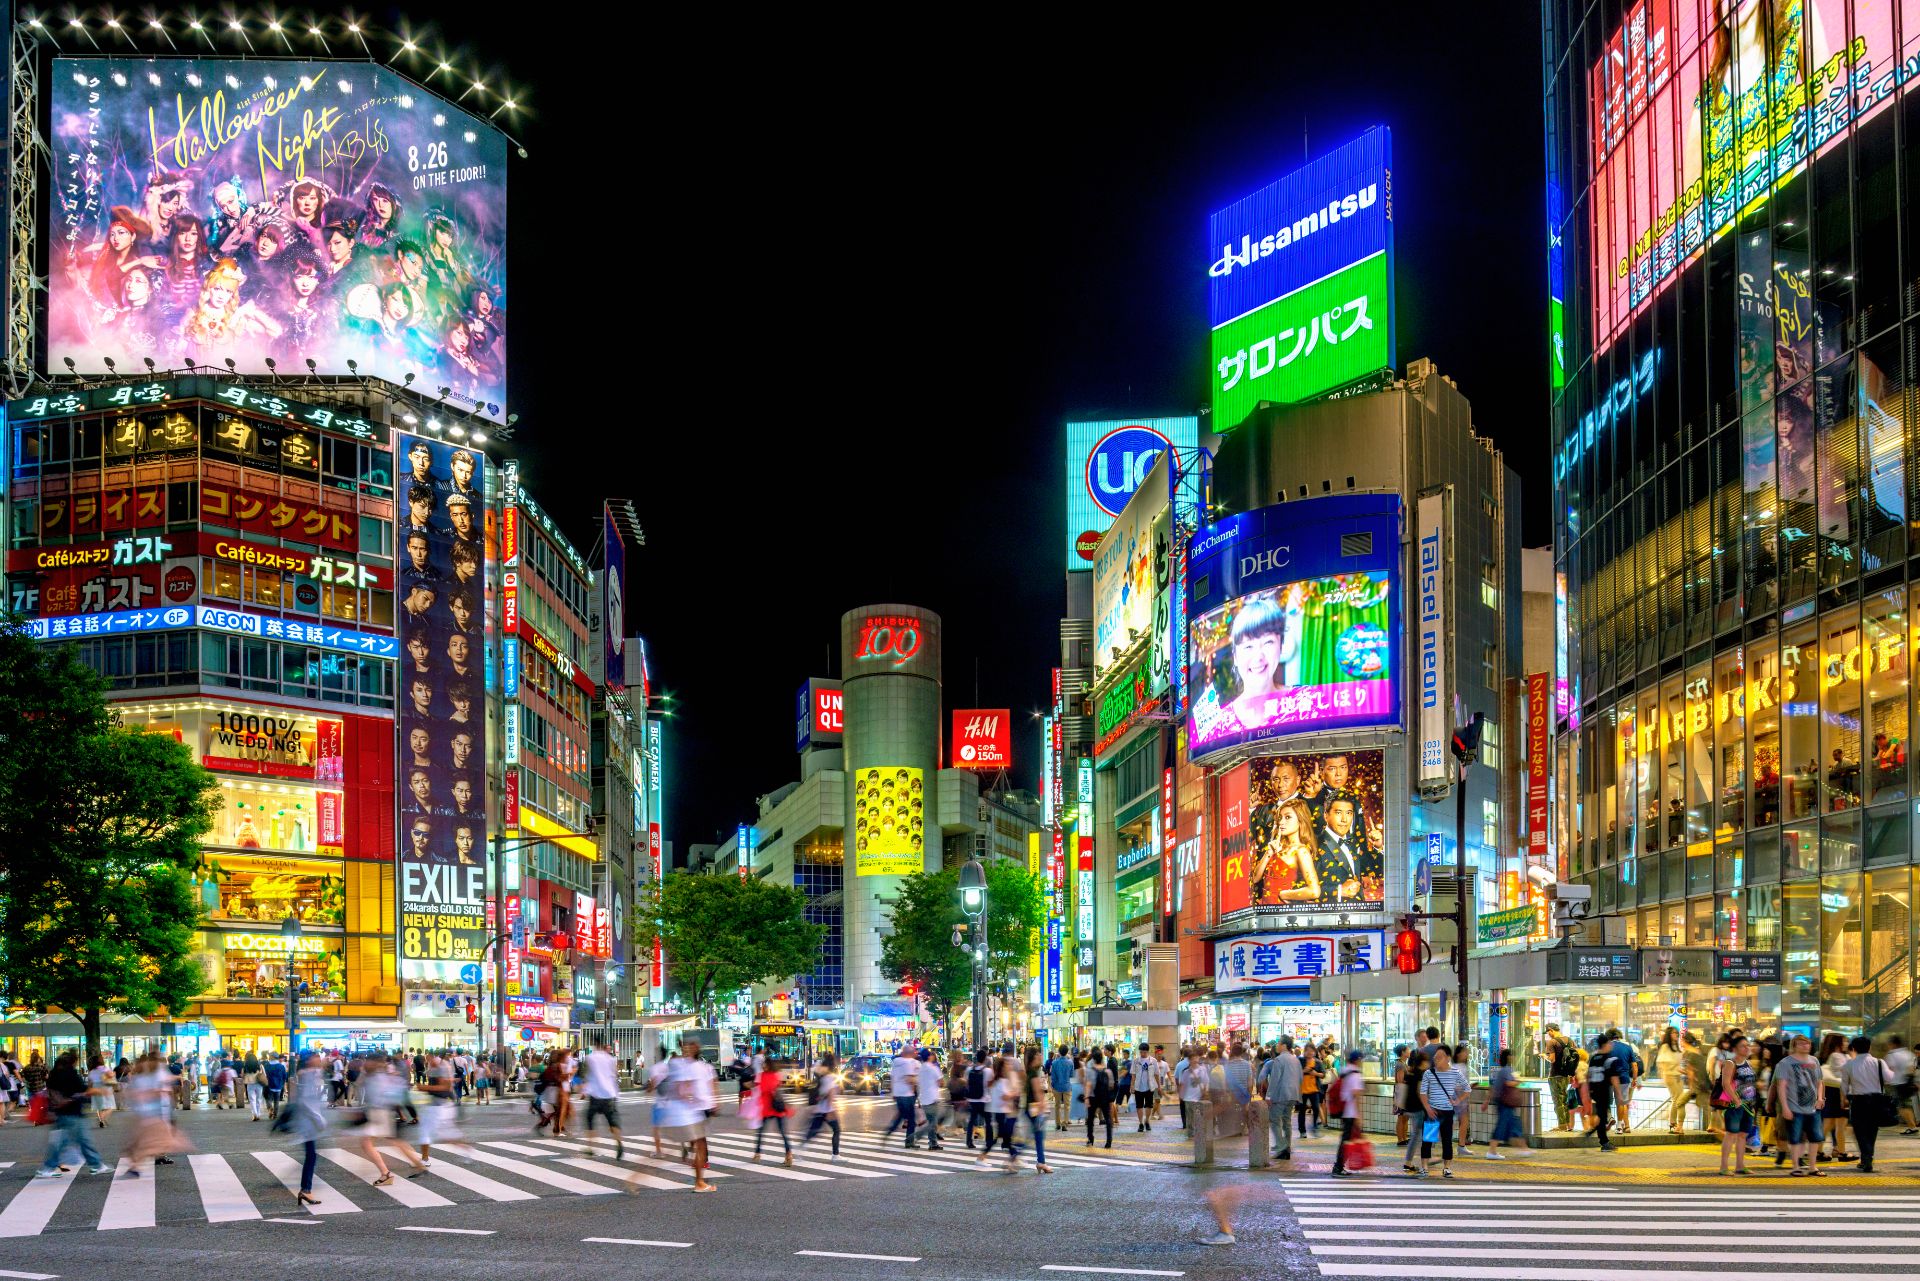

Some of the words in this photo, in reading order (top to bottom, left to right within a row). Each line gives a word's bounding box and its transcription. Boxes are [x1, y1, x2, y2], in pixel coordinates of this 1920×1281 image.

[149, 68, 327, 175] Halloween
[258, 107, 346, 203] Night
[320, 117, 390, 181] AKB48
[408, 141, 448, 172] 8.26
[413, 174, 426, 190] ON
[428, 171, 447, 187] THE
[449, 165, 486, 184] FLOOR!!
[1208, 182, 1377, 277] Hisamitsu
[1217, 295, 1373, 392] サロンパス
[25, 395, 81, 416] 月の宴
[108, 383, 166, 405] 月の宴
[217, 386, 288, 418] 月の宴
[116, 417, 128, 427] 9F
[217, 412, 231, 422] 9F
[304, 409, 372, 438] 月の宴
[43, 489, 164, 529] プライス
[202, 488, 354, 540] コンタクト
[113, 536, 173, 566] ガスト
[1191, 538, 1206, 560] DHC
[1206, 525, 1239, 548] Channel
[310, 556, 378, 588] ガスト
[1240, 546, 1290, 578] DHC
[1421, 526, 1440, 622] Taisei
[12, 588, 39, 611] 7F
[46, 584, 77, 601] Café
[81, 576, 154, 614] ガスト
[168, 581, 193, 592] ガスト
[52, 612, 160, 636] 英会話イーオン
[168, 612, 184, 623] 6F
[202, 609, 256, 632] AEON
[506, 598, 515, 627] ガスト
[867, 617, 921, 627] SHIBUYA
[266, 619, 394, 653] 英会話イーオン
[854, 625, 922, 666] 109
[557, 651, 575, 680] ガスト
[1423, 630, 1436, 708] neon
[217, 711, 301, 741] 1000%
[507, 710, 515, 759] 渋谷駅前ビル
[650, 727, 658, 744] BIC
[964, 716, 999, 739] H&M
[1257, 728, 1275, 738] DHC
[1532, 678, 1544, 777] クスリのことなら
[977, 751, 1003, 761] 150m
[1422, 749, 1441, 758] 3719
[1423, 740, 1440, 749] (03)
[650, 746, 659, 791] CAMERA
[1422, 758, 1441, 766] 2468
[1226, 799, 1242, 830] No.1
[1530, 785, 1547, 847] 三千里
[1222, 830, 1247, 859] DMM
[252, 859, 298, 867] L'OCCITANE
[1226, 855, 1243, 882] FX
[402, 861, 484, 906] EXILE
[403, 903, 439, 913] 24karats
[440, 905, 462, 914] GOLD
[463, 906, 484, 915] SOUL
[403, 914, 436, 928] NEW
[437, 915, 484, 930] SINGLE
[404, 927, 453, 959] 8.19
[454, 938, 469, 949] ON
[1578, 965, 1611, 977] 渋谷駅
